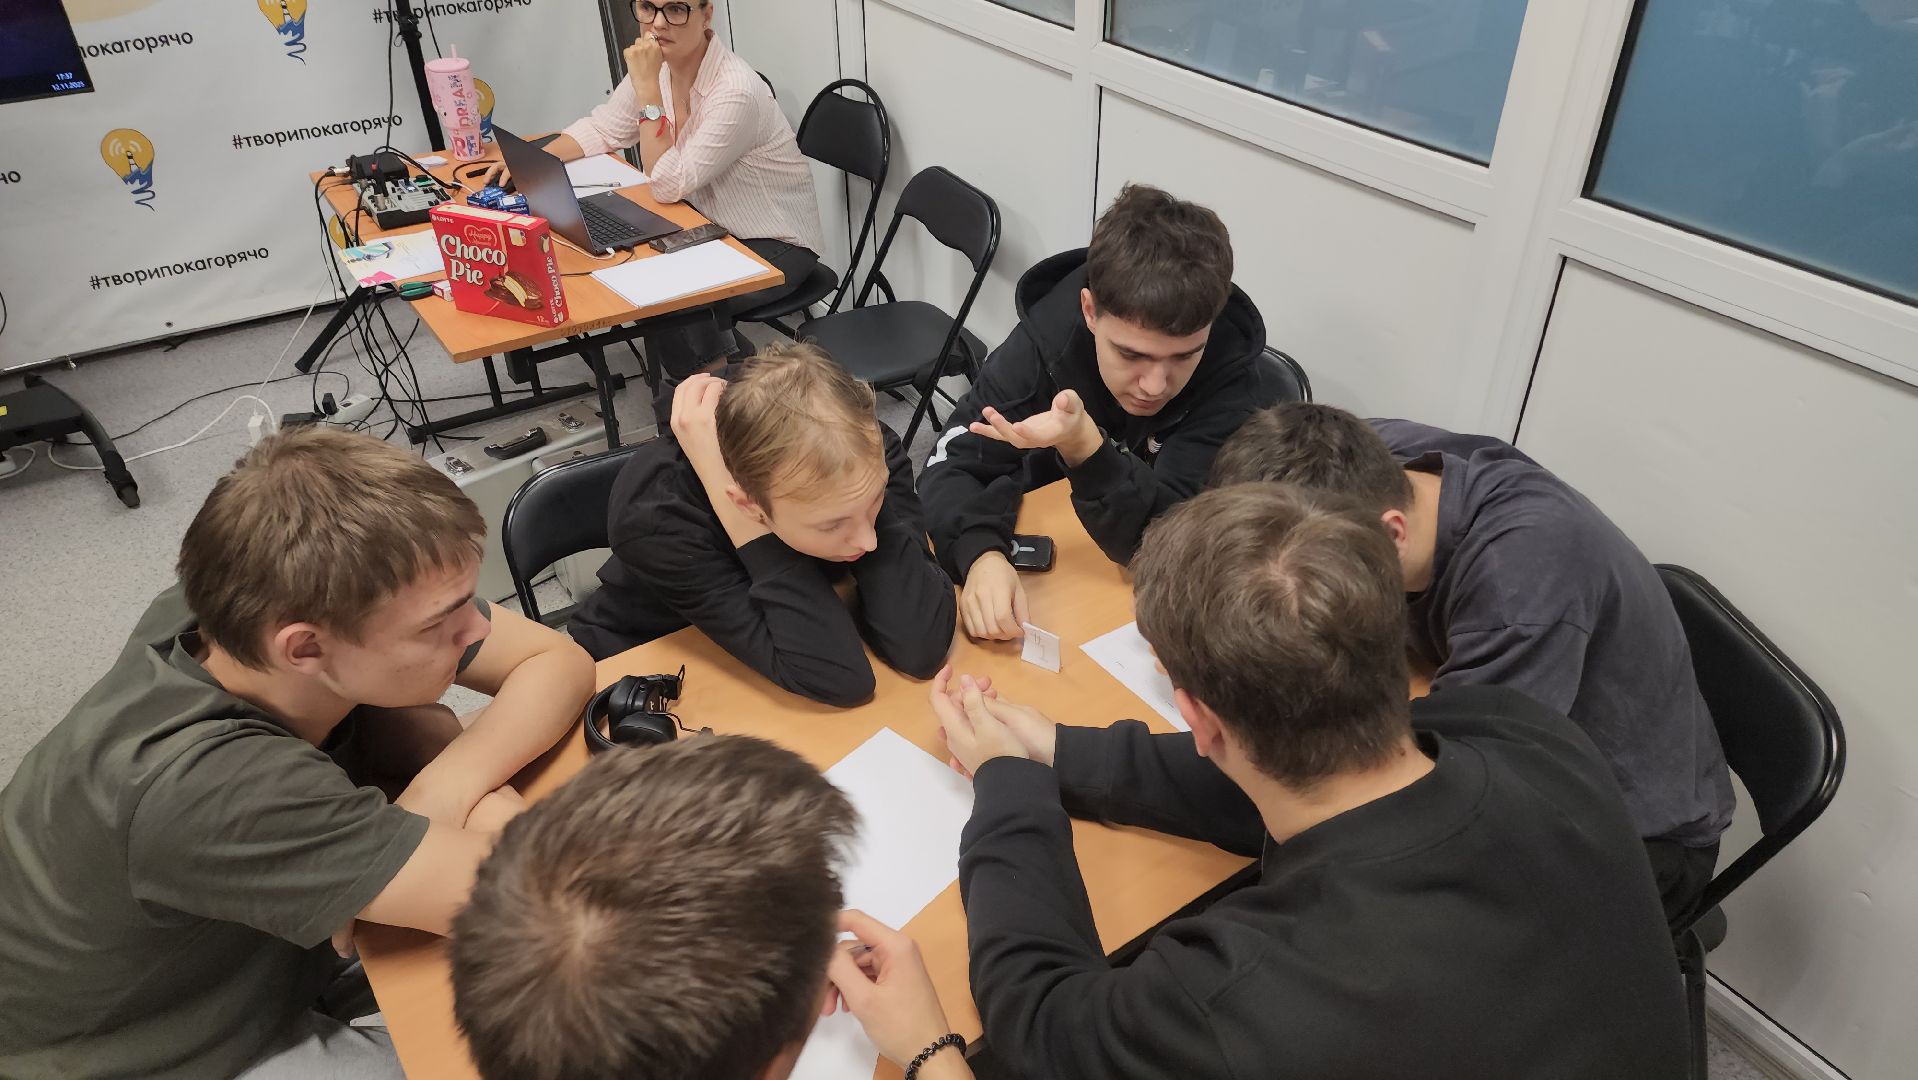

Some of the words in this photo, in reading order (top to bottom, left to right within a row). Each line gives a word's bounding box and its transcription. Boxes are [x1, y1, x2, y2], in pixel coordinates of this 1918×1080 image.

[232, 115, 403, 149] #творипокагорячо
[441, 234, 506, 266] Choco
[547, 256, 555, 274] Pie
[89, 247, 269, 290] #творипокагорячо
[450, 258, 484, 286] Pie
[552, 275, 562, 308] Choco
